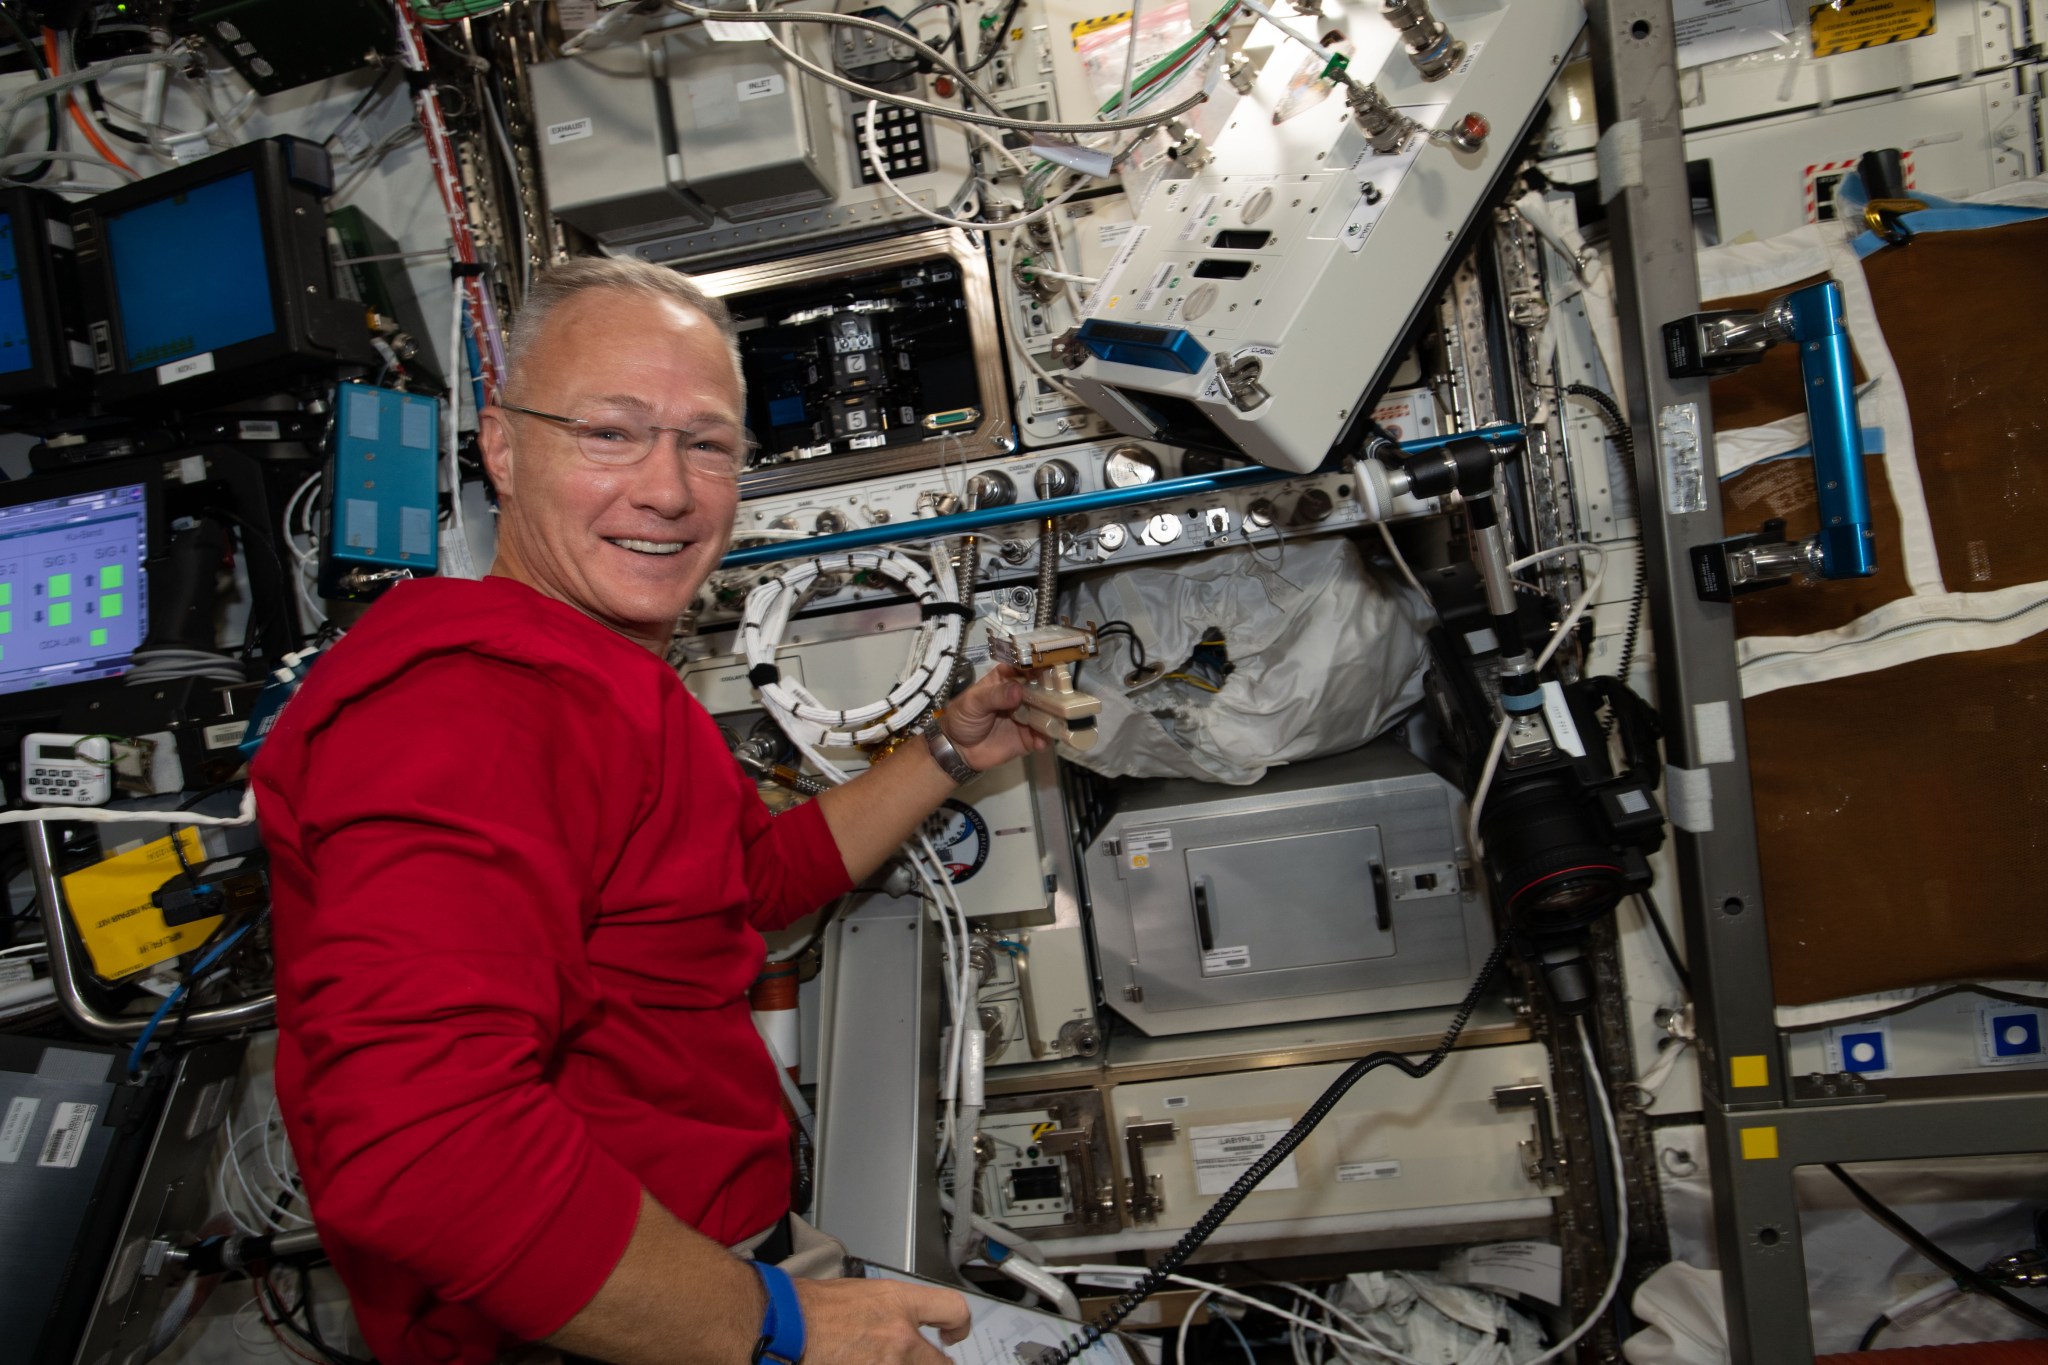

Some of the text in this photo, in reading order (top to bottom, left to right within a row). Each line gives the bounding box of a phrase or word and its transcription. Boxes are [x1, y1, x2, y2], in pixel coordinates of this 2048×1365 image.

[1849, 3, 1894, 17] WARNING
[748, 79, 771, 90] INLET
[551, 120, 588, 136] EXHAUST
[851, 356, 863, 371] 2
[1204, 375, 1220, 397] OPEN
[851, 412, 863, 428] 5
[1008, 462, 1037, 473] COOLANT
[894, 482, 917, 491] LAPTOP
[94, 544, 128, 560] SIG 4
[43, 552, 78, 569] SIG 3
[9, 562, 19, 575] 2
[721, 673, 745, 682] COOLANT
[111, 906, 142, 924] REPAIR
